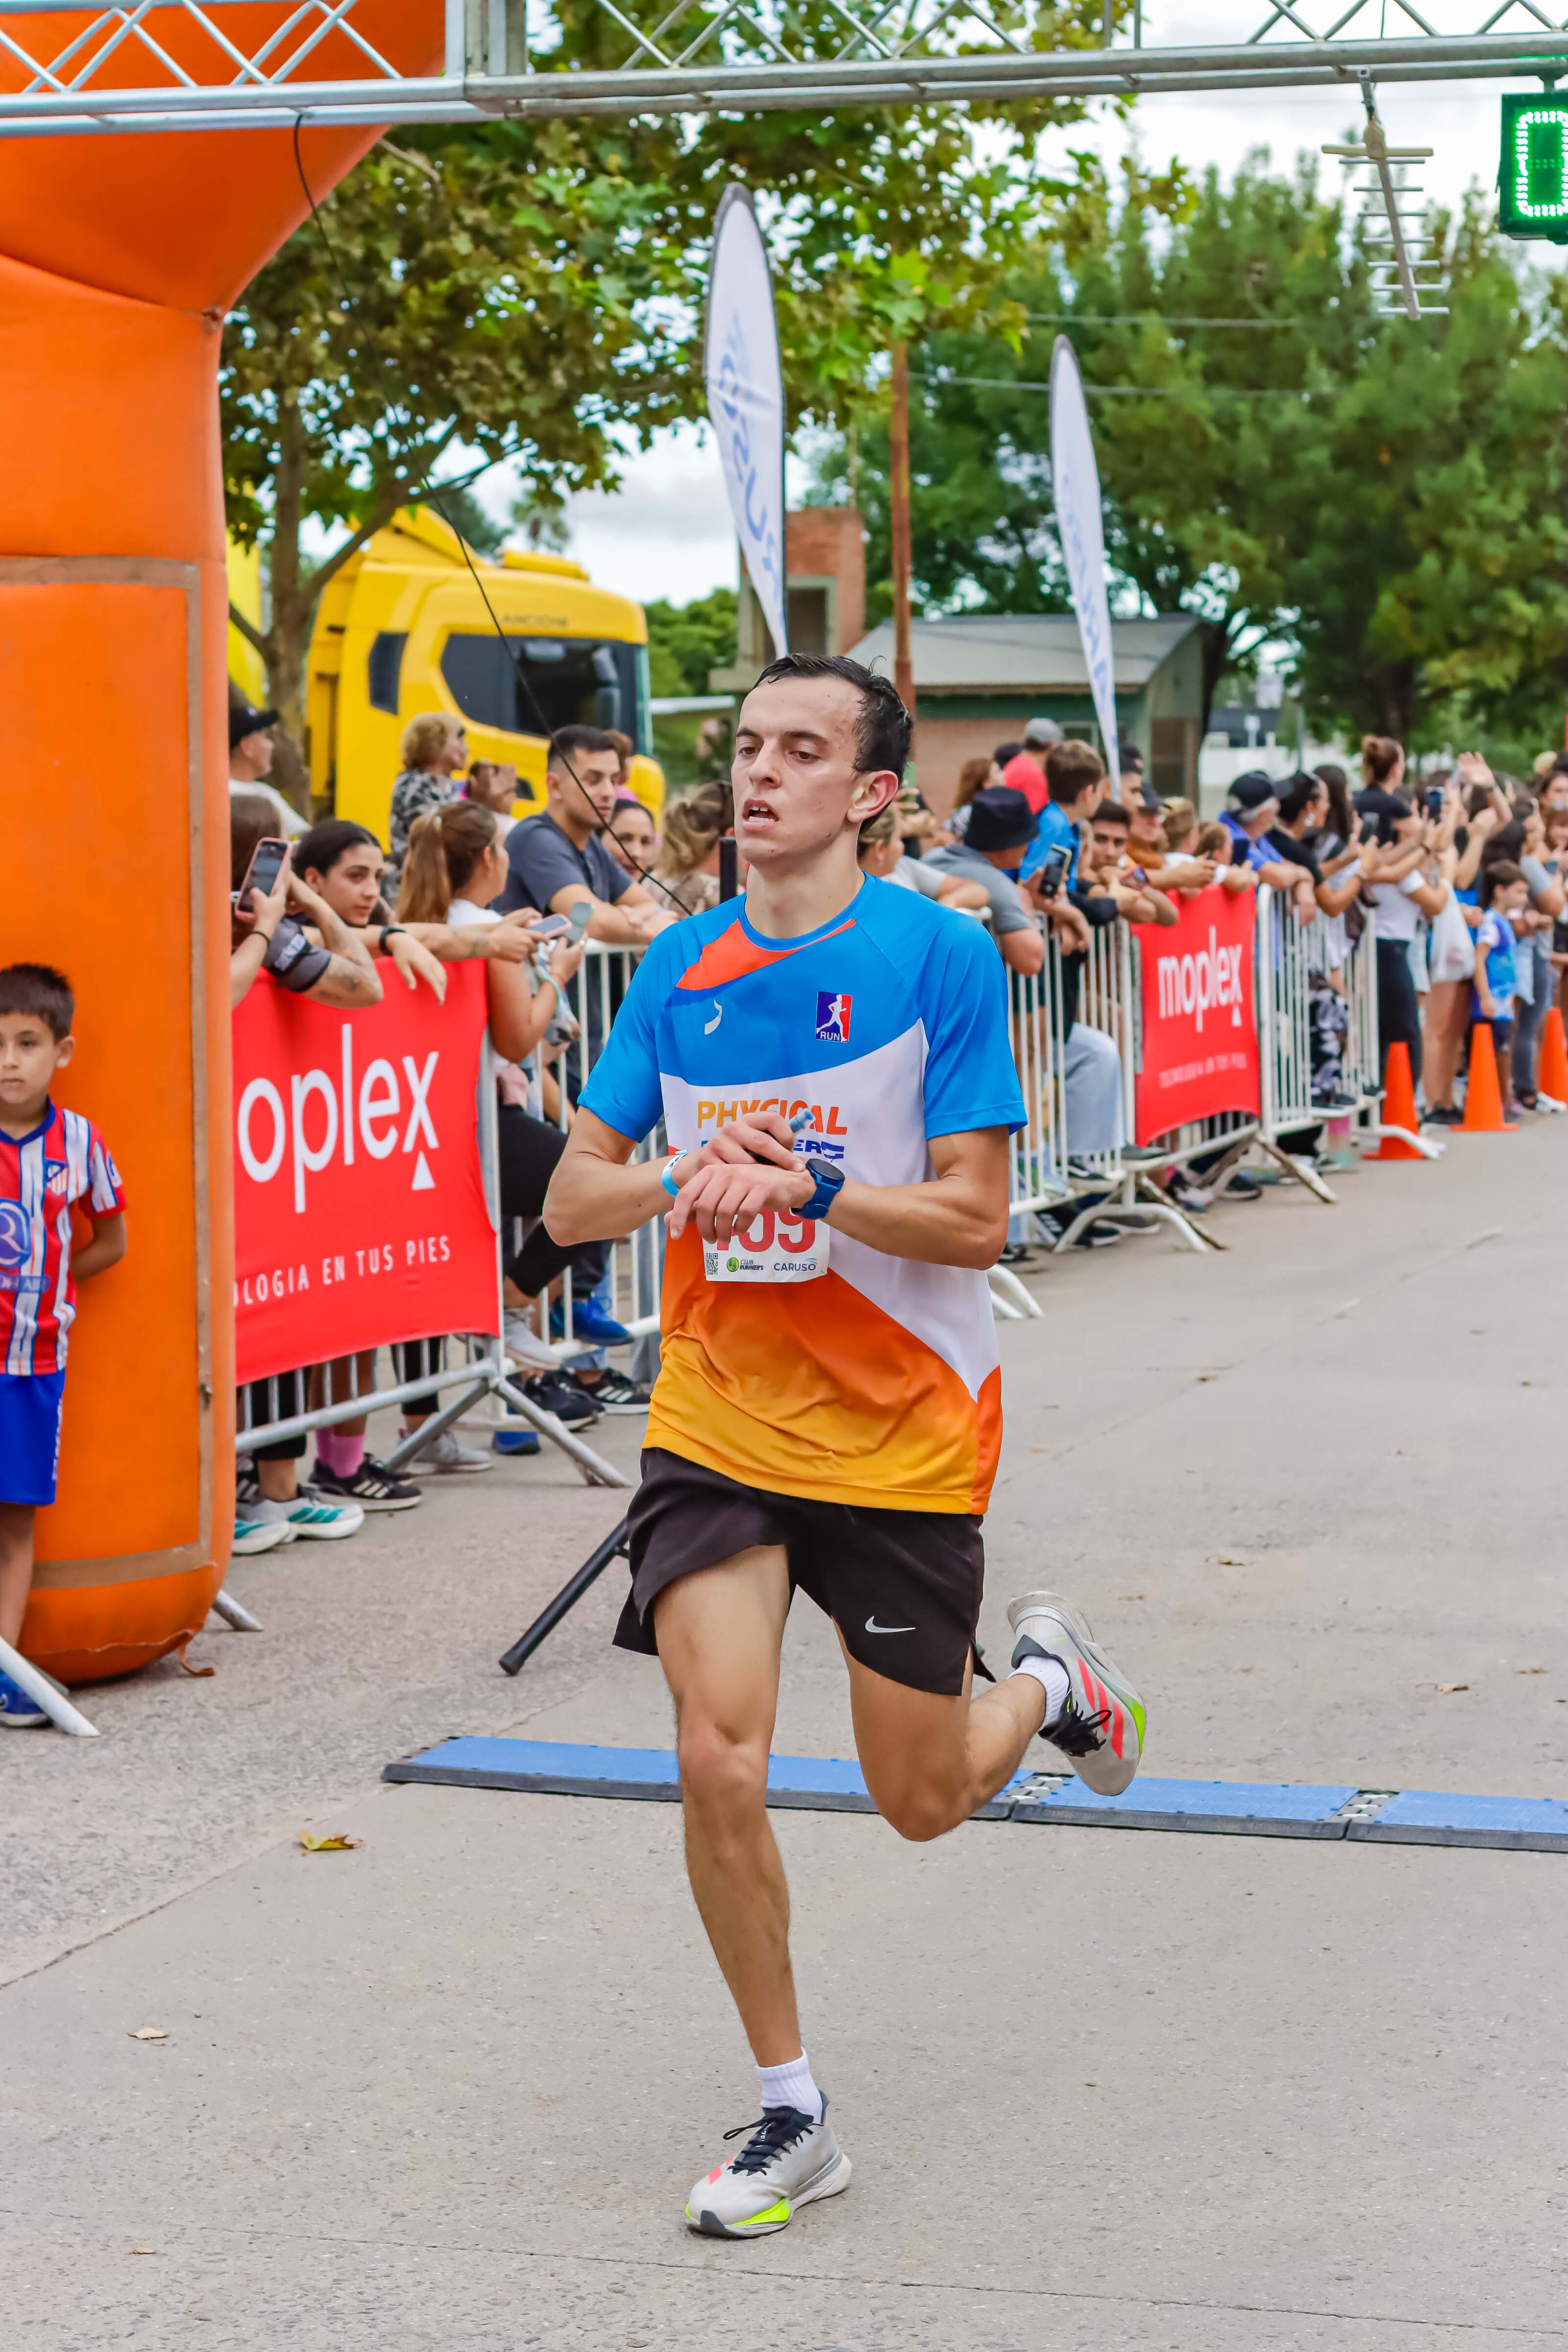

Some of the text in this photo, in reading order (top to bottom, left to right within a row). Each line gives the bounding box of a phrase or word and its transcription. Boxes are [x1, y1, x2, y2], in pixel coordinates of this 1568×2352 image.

[1516, 110, 1568, 217] 0
[1157, 925, 1244, 1032] moplex
[820, 1031, 840, 1041] RUN
[322, 1255, 345, 1285] EN
[356, 1244, 393, 1276] TUS
[406, 1235, 450, 1266] PIES
[774, 1263, 816, 1272] CARUSO
